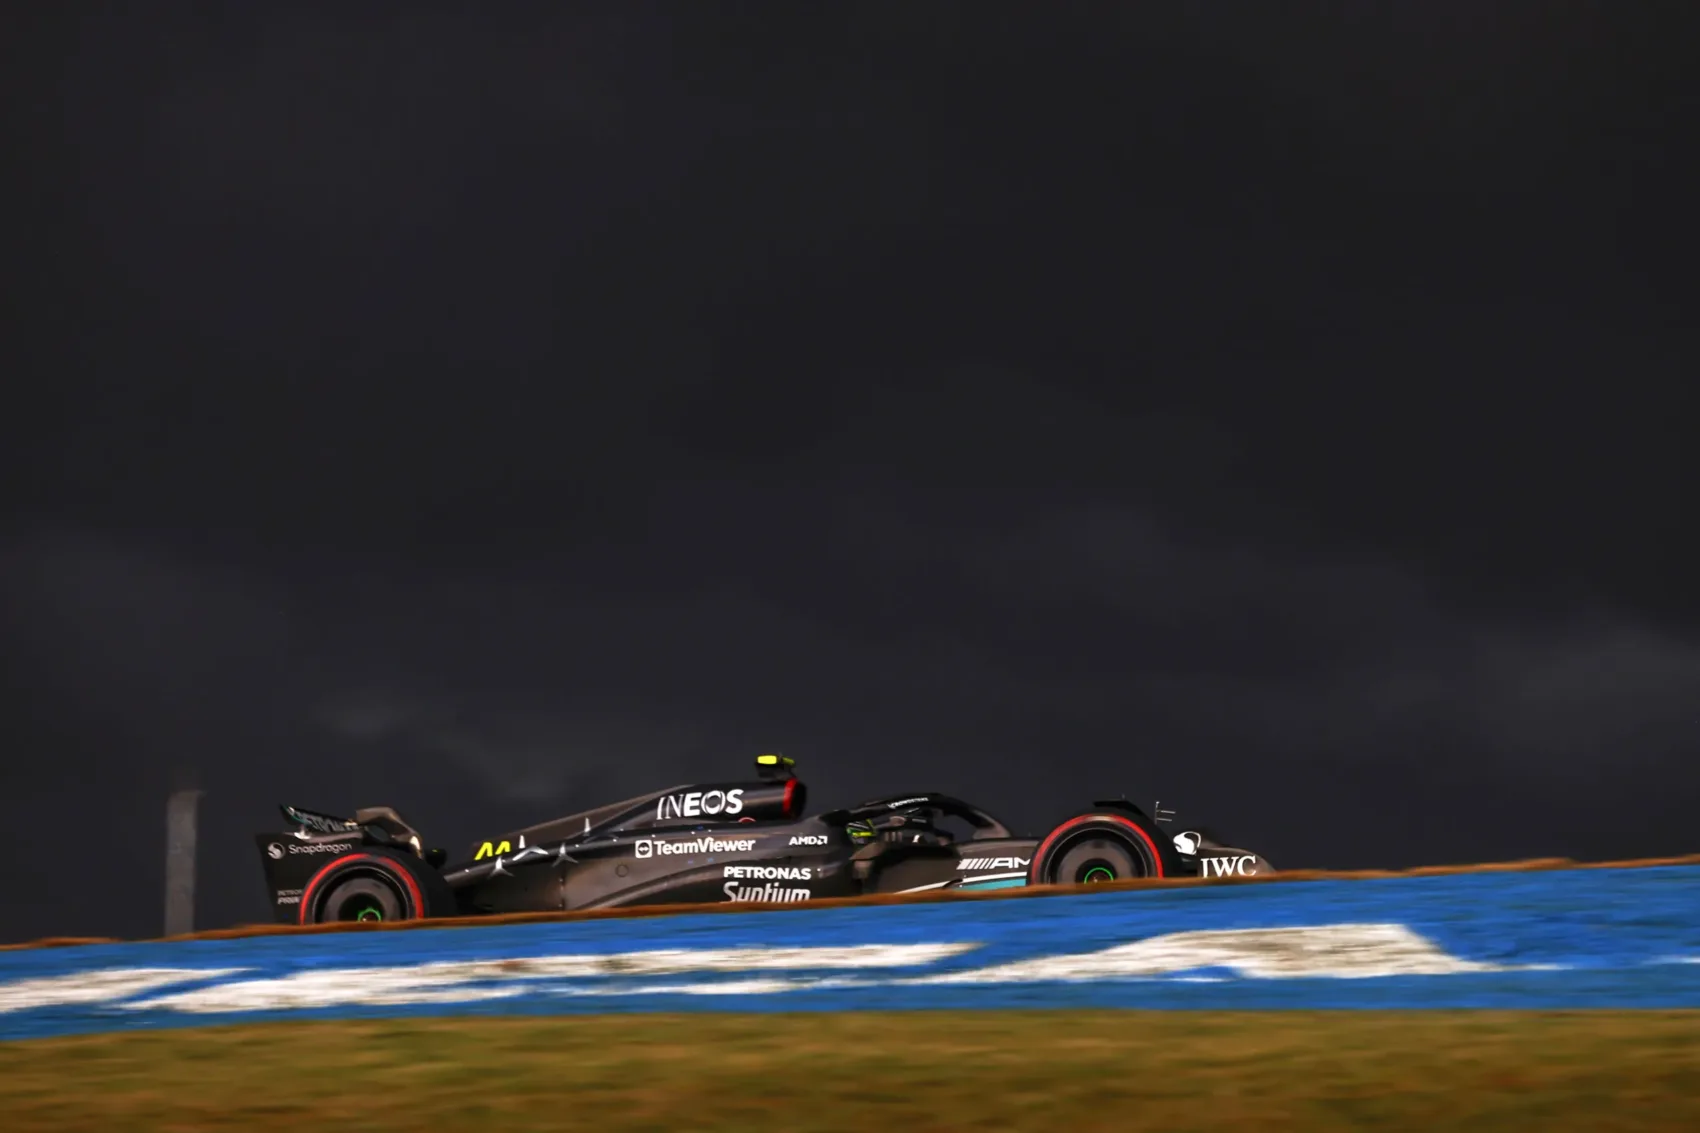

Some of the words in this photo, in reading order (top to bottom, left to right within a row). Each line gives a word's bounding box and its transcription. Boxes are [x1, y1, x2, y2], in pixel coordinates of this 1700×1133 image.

[656, 789, 744, 820] INEOS
[653, 836, 756, 856] TeamViewer
[789, 836, 817, 846] AMD
[288, 842, 352, 855] Snapdragon
[988, 857, 1031, 870] AM
[1201, 855, 1256, 878] IWC
[723, 866, 811, 880] PETRONAS
